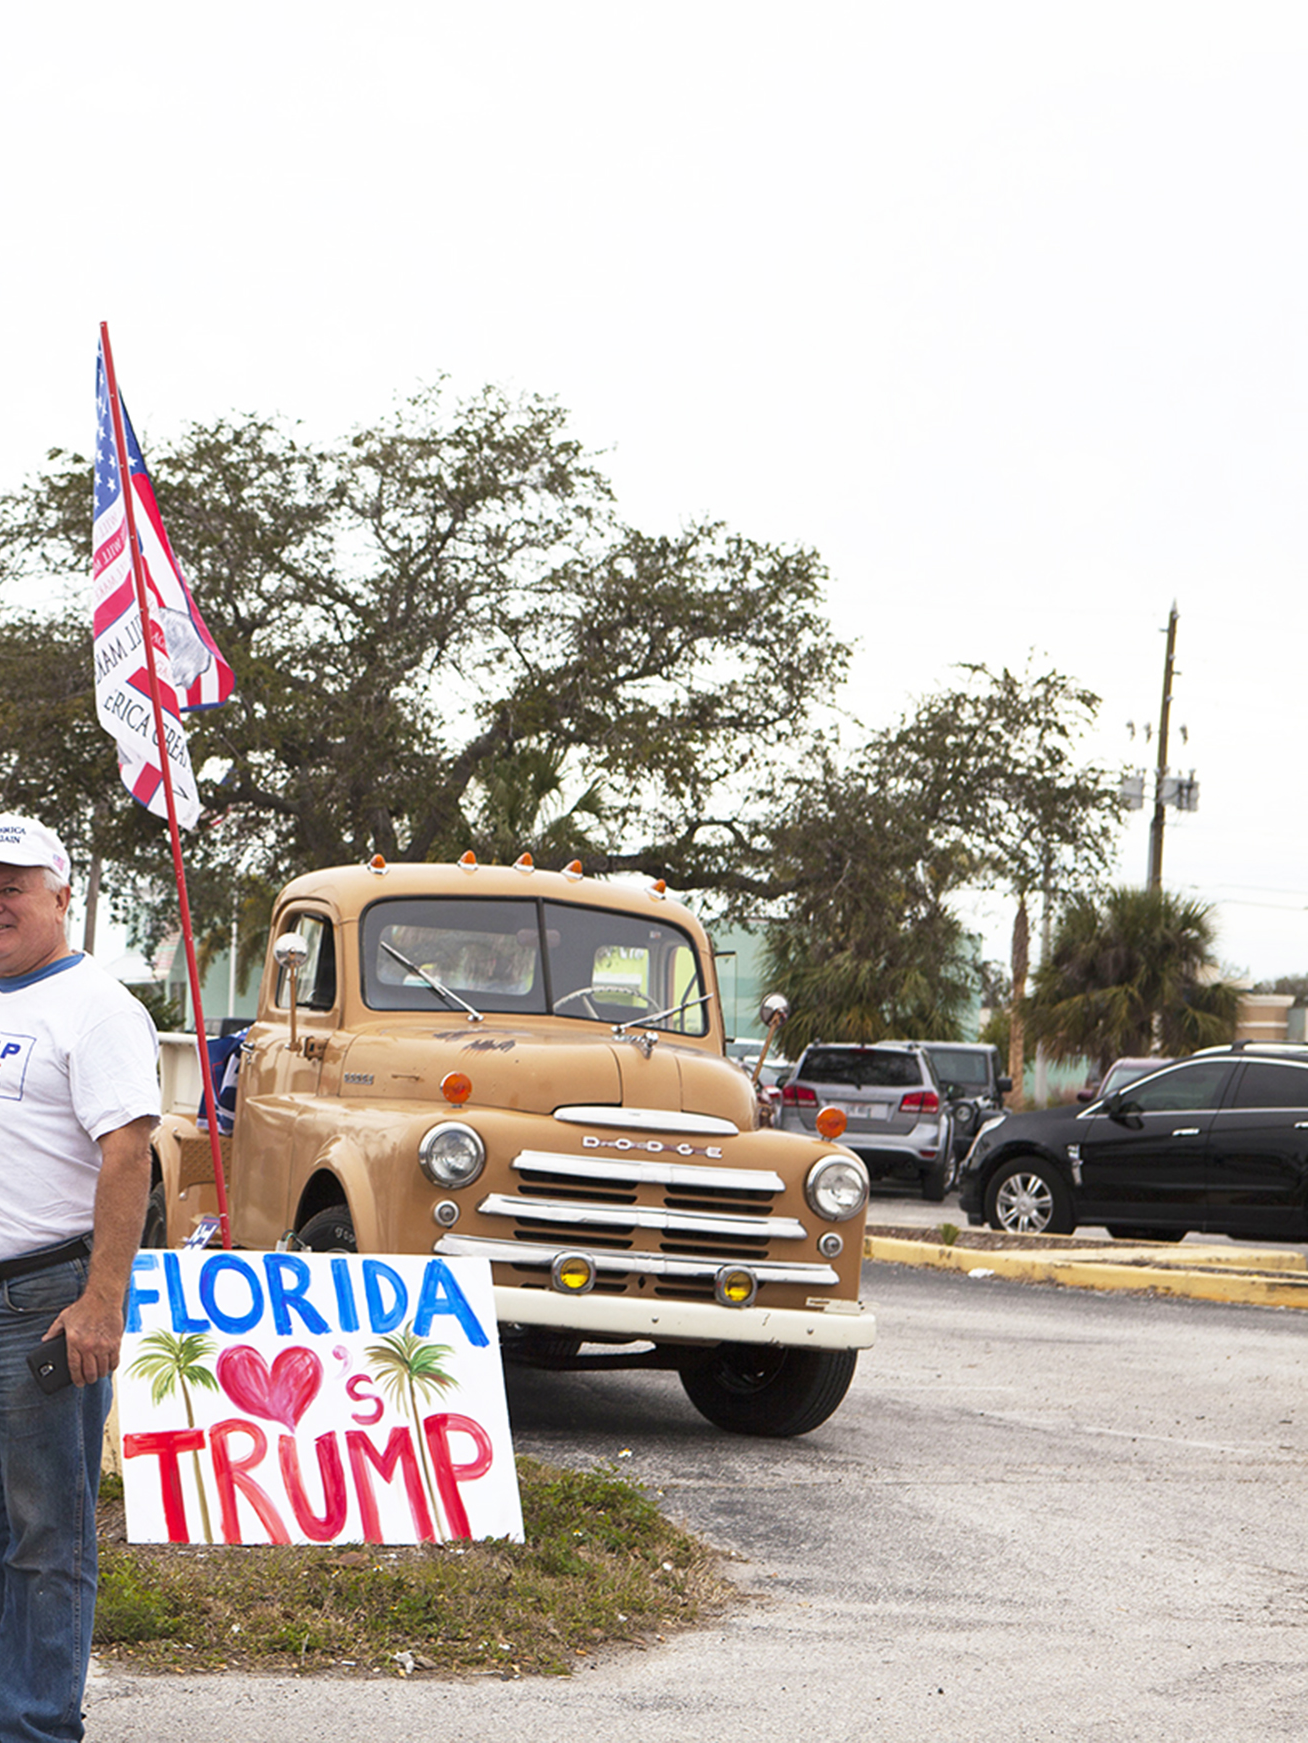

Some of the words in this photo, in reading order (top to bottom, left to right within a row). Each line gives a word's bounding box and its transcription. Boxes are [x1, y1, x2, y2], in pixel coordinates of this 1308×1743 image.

[152, 721, 190, 772] GREA
[582, 1136, 723, 1160] DODGE
[126, 1253, 490, 1348] FLORIDA
[123, 1413, 493, 1545] TRUMP
